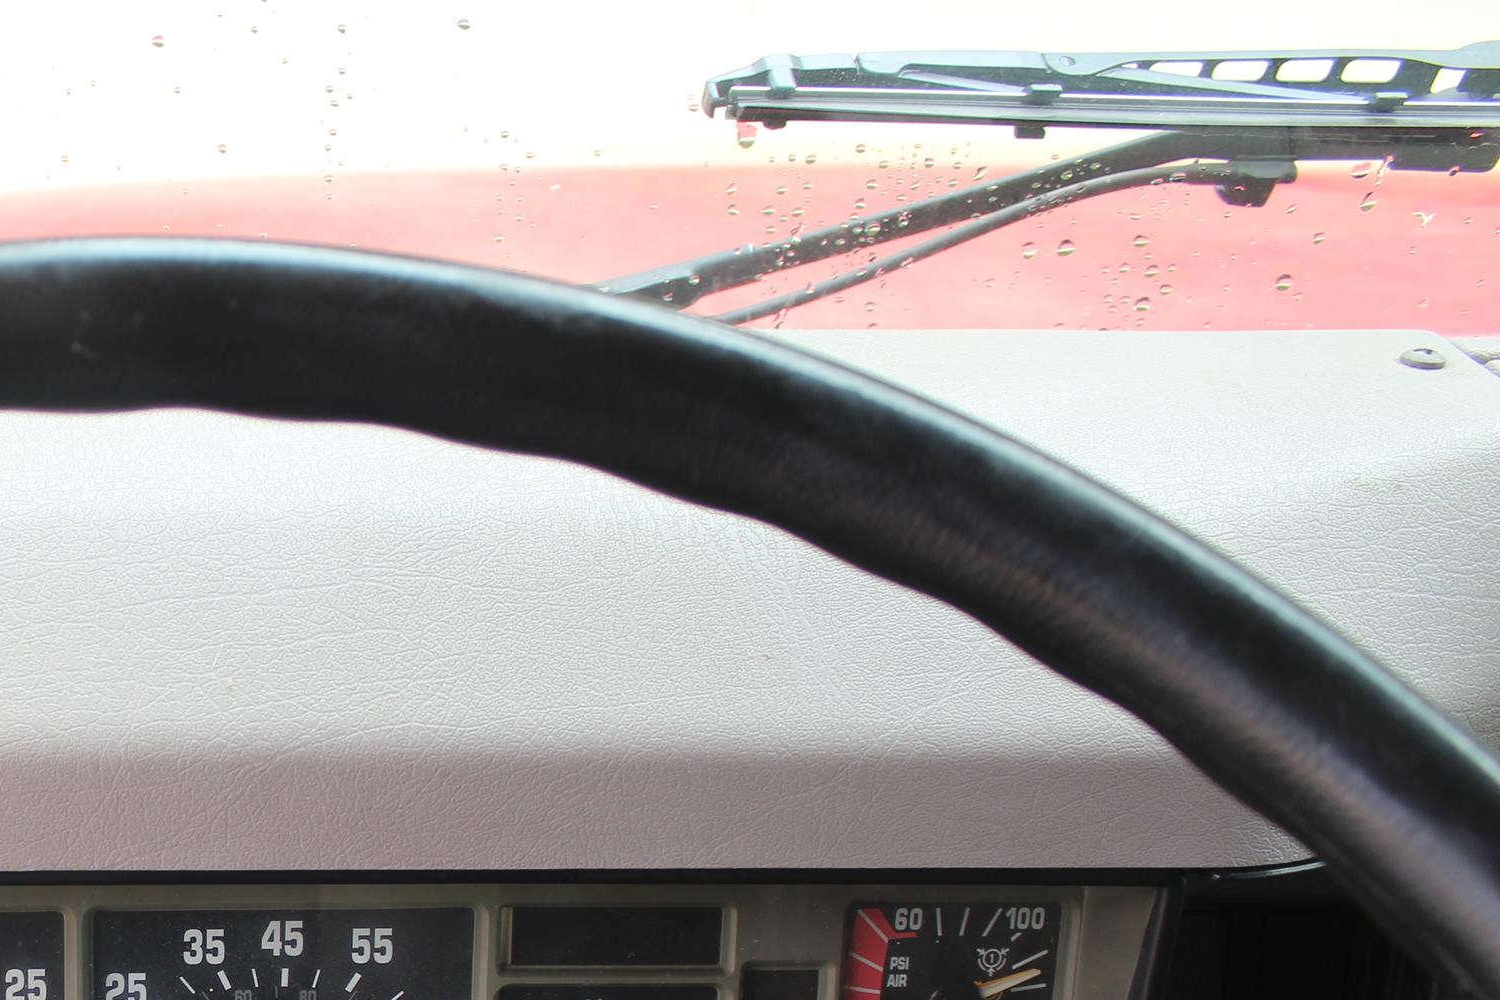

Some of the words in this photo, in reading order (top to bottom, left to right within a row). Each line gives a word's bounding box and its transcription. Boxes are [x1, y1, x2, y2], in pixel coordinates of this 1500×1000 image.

[894, 907, 924, 931] 60
[1006, 907, 1046, 930] 100
[182, 928, 226, 965] 35
[261, 920, 303, 957] 45
[351, 927, 394, 964] 55
[889, 956, 910, 970] PSI
[886, 973, 908, 988] AIR
